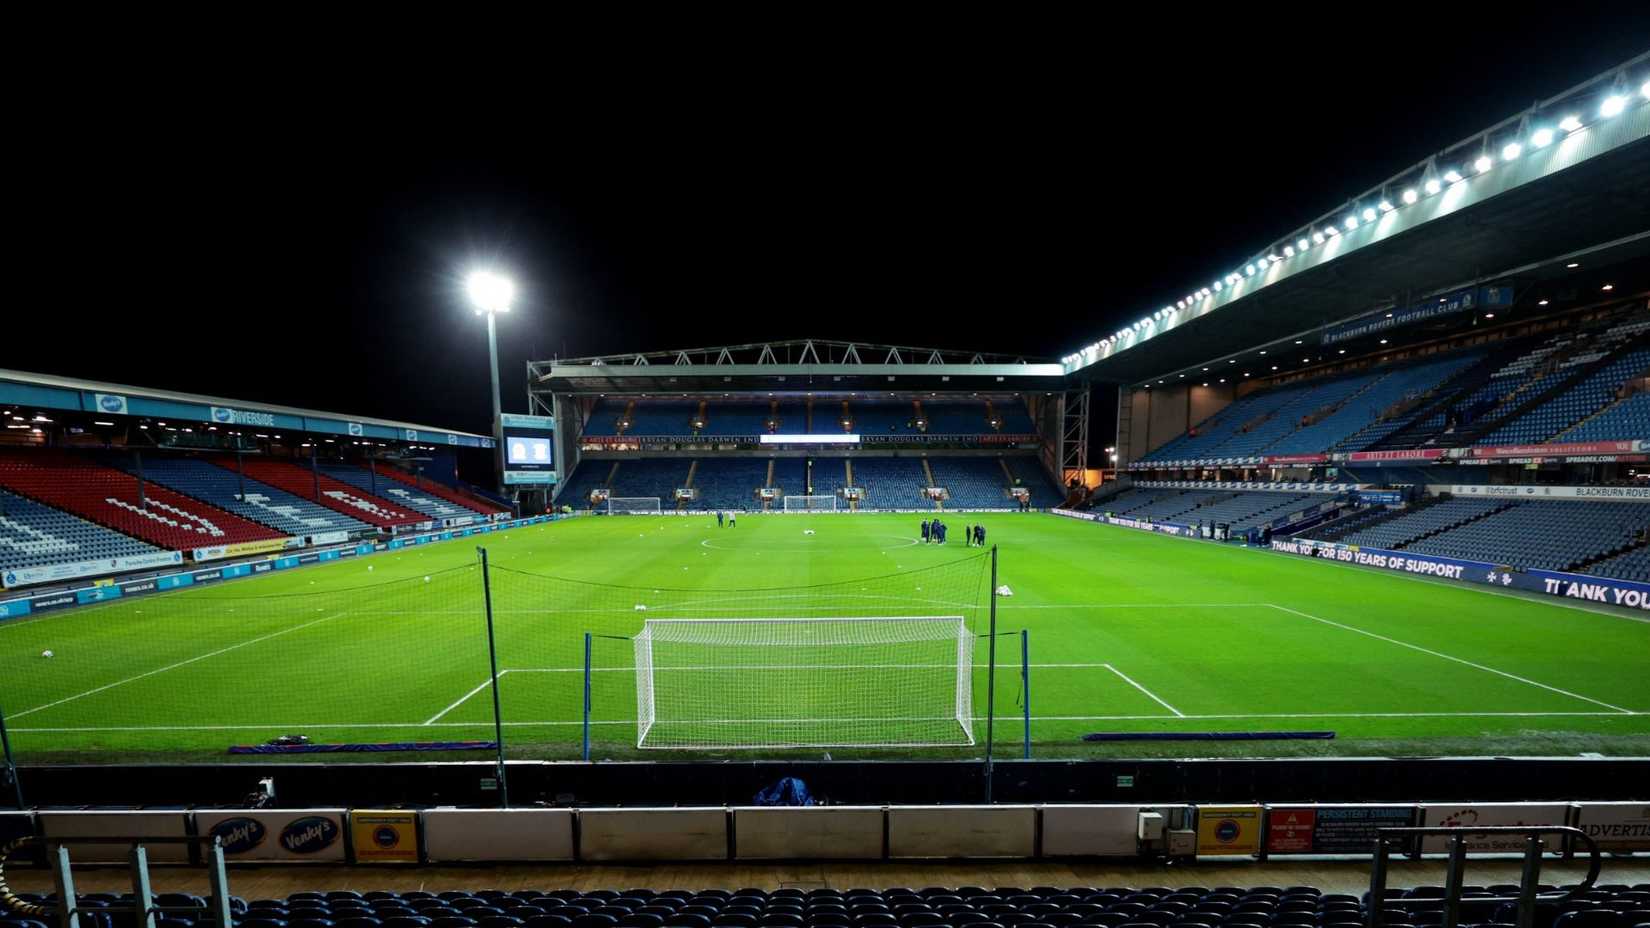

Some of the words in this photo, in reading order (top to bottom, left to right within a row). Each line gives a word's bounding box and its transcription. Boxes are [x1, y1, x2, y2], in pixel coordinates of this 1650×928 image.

[1396, 308, 1435, 325] FOOTBALL
[1437, 300, 1458, 313] CLUB
[232, 410, 275, 426] RIVERSIDE
[1576, 488, 1624, 497] BLACKBURN
[1272, 540, 1298, 553] THANK
[1337, 549, 1352, 560] 150
[1353, 550, 1387, 568] YEARS
[1388, 555, 1405, 570] OF
[1405, 557, 1463, 580] SUPPORT
[221, 822, 258, 847] enky's
[286, 821, 331, 848] Venky's
